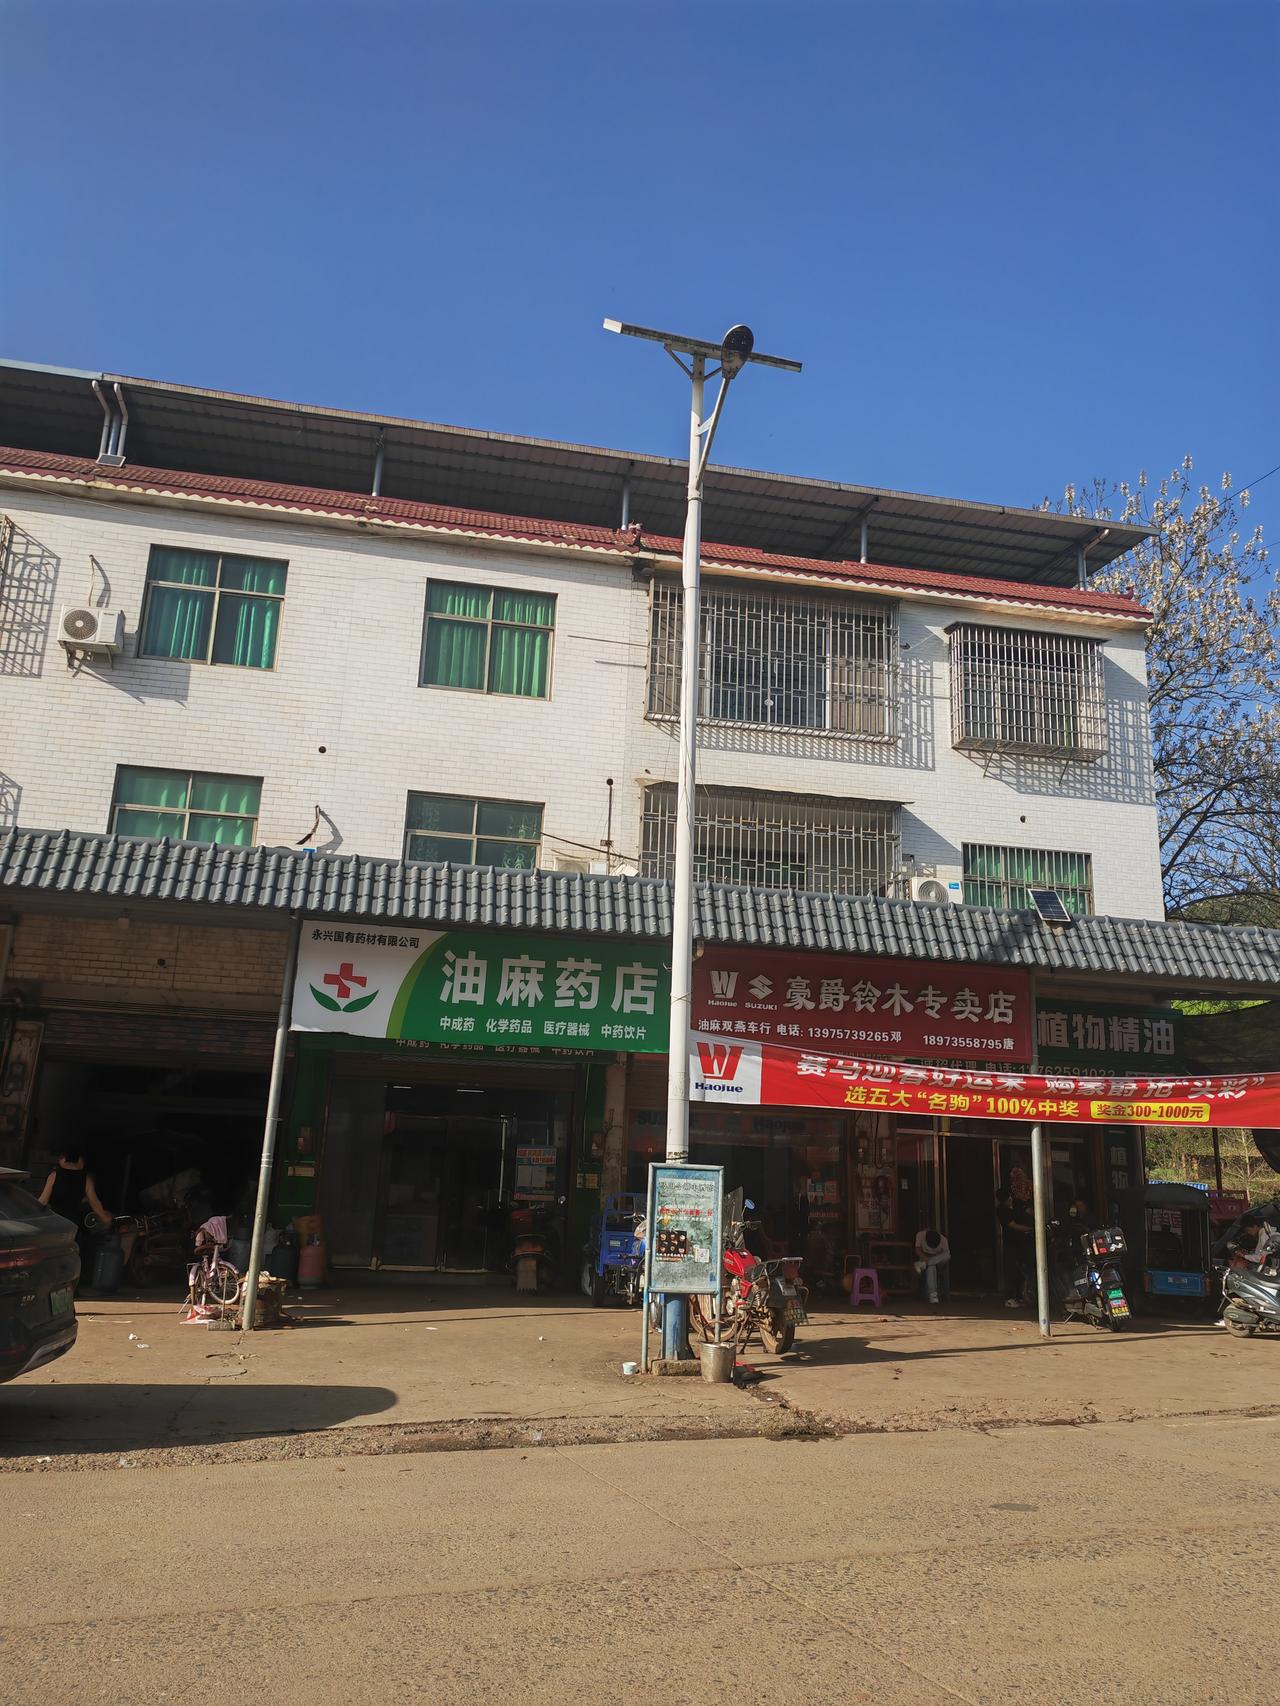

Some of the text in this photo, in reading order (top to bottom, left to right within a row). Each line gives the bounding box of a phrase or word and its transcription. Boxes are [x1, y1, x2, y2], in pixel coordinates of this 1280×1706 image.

[439, 950, 659, 1015] 油麻药店
[745, 1002, 778, 1011] SUZUKI
[783, 976, 1016, 1025] 豪爵铃木专卖店
[439, 1015, 647, 1040] 中成药 化学药品 医疗器械 中药饮片
[698, 1019, 772, 1034] 油麻双燕车行
[922, 1034, 1015, 1050] 18973558795唐
[1037, 1010, 1175, 1055] 植物精油
[694, 1082, 744, 1093] Haojue
[1096, 1102, 1204, 1119] 奖金300-1000元
